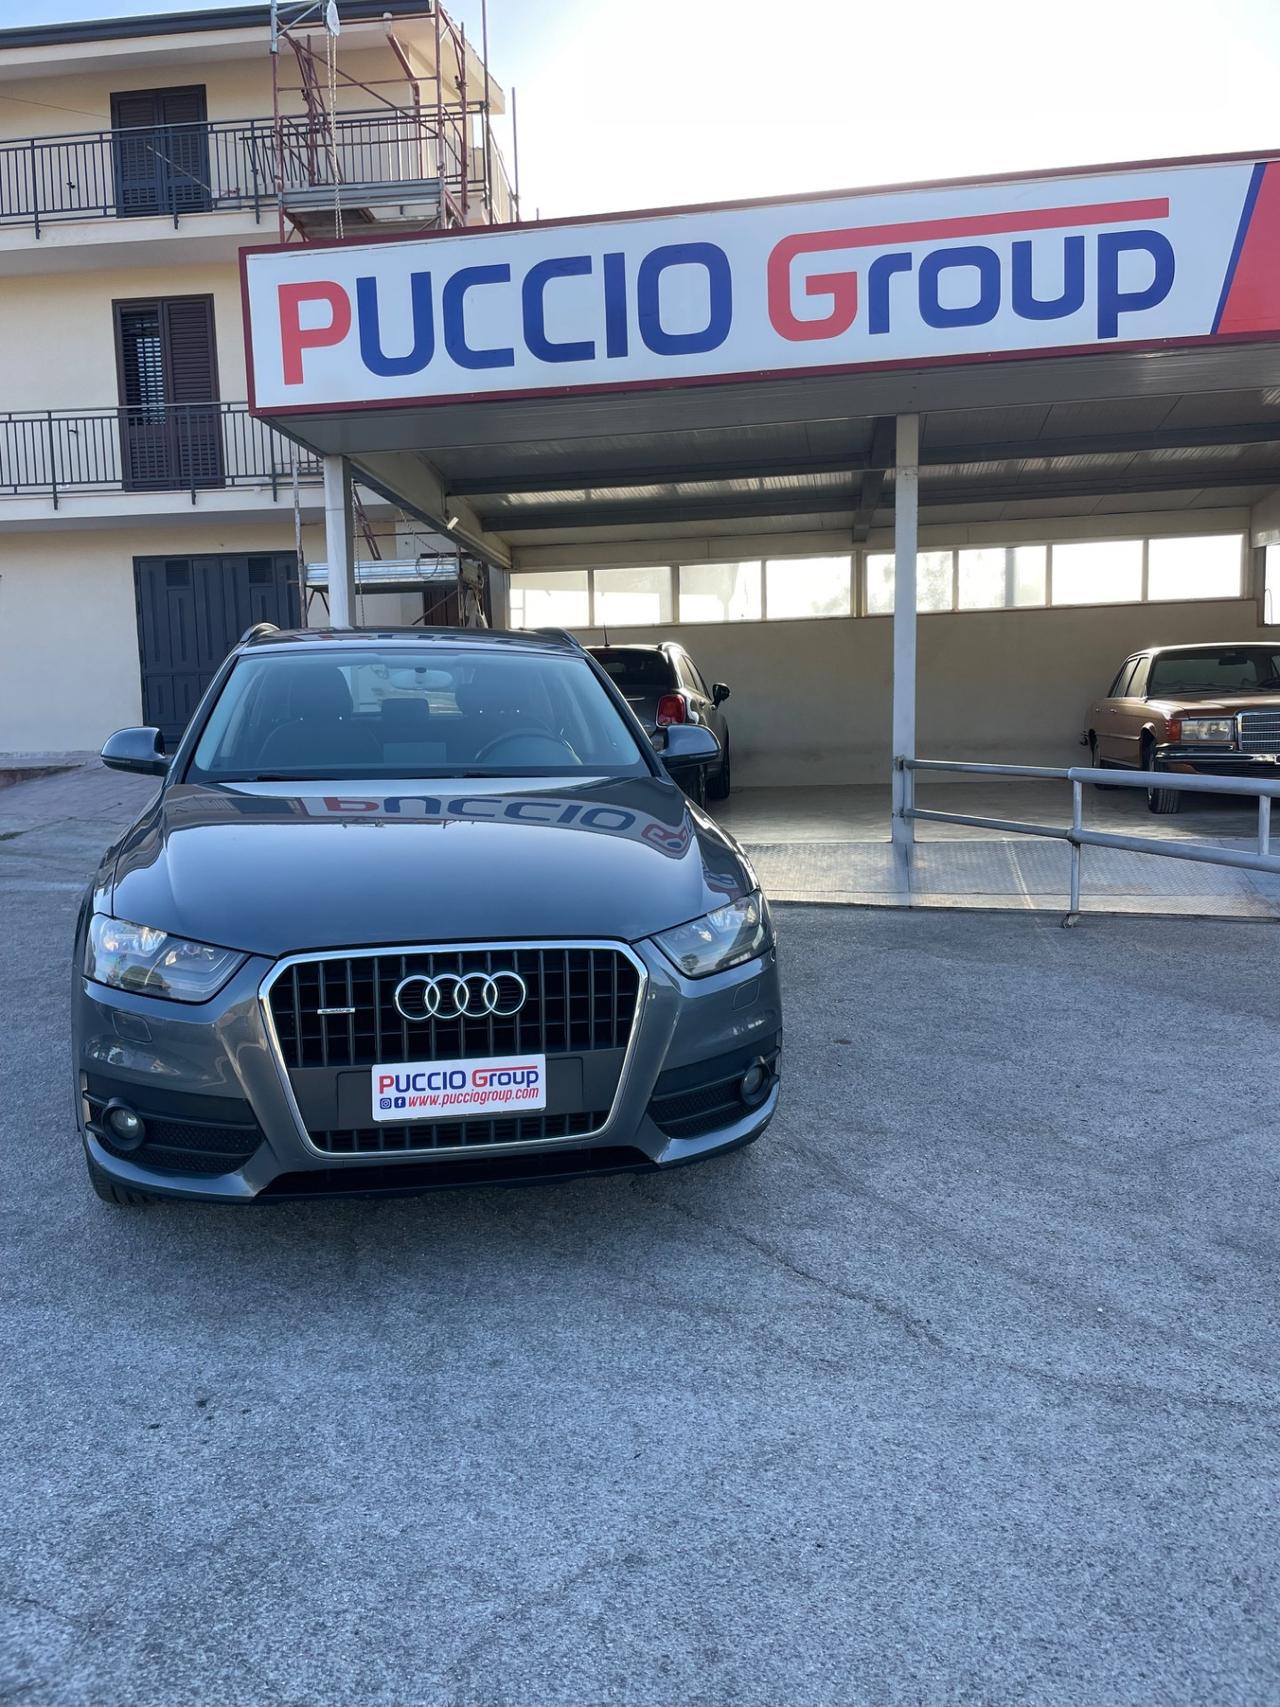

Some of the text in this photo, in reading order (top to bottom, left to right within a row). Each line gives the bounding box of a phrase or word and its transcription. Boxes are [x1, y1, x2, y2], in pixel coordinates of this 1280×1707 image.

[279, 197, 1175, 385] PUCCIO Group
[379, 1065, 539, 1094] PUCCIO Group
[408, 1087, 539, 1108] www.pucciogroup.com
